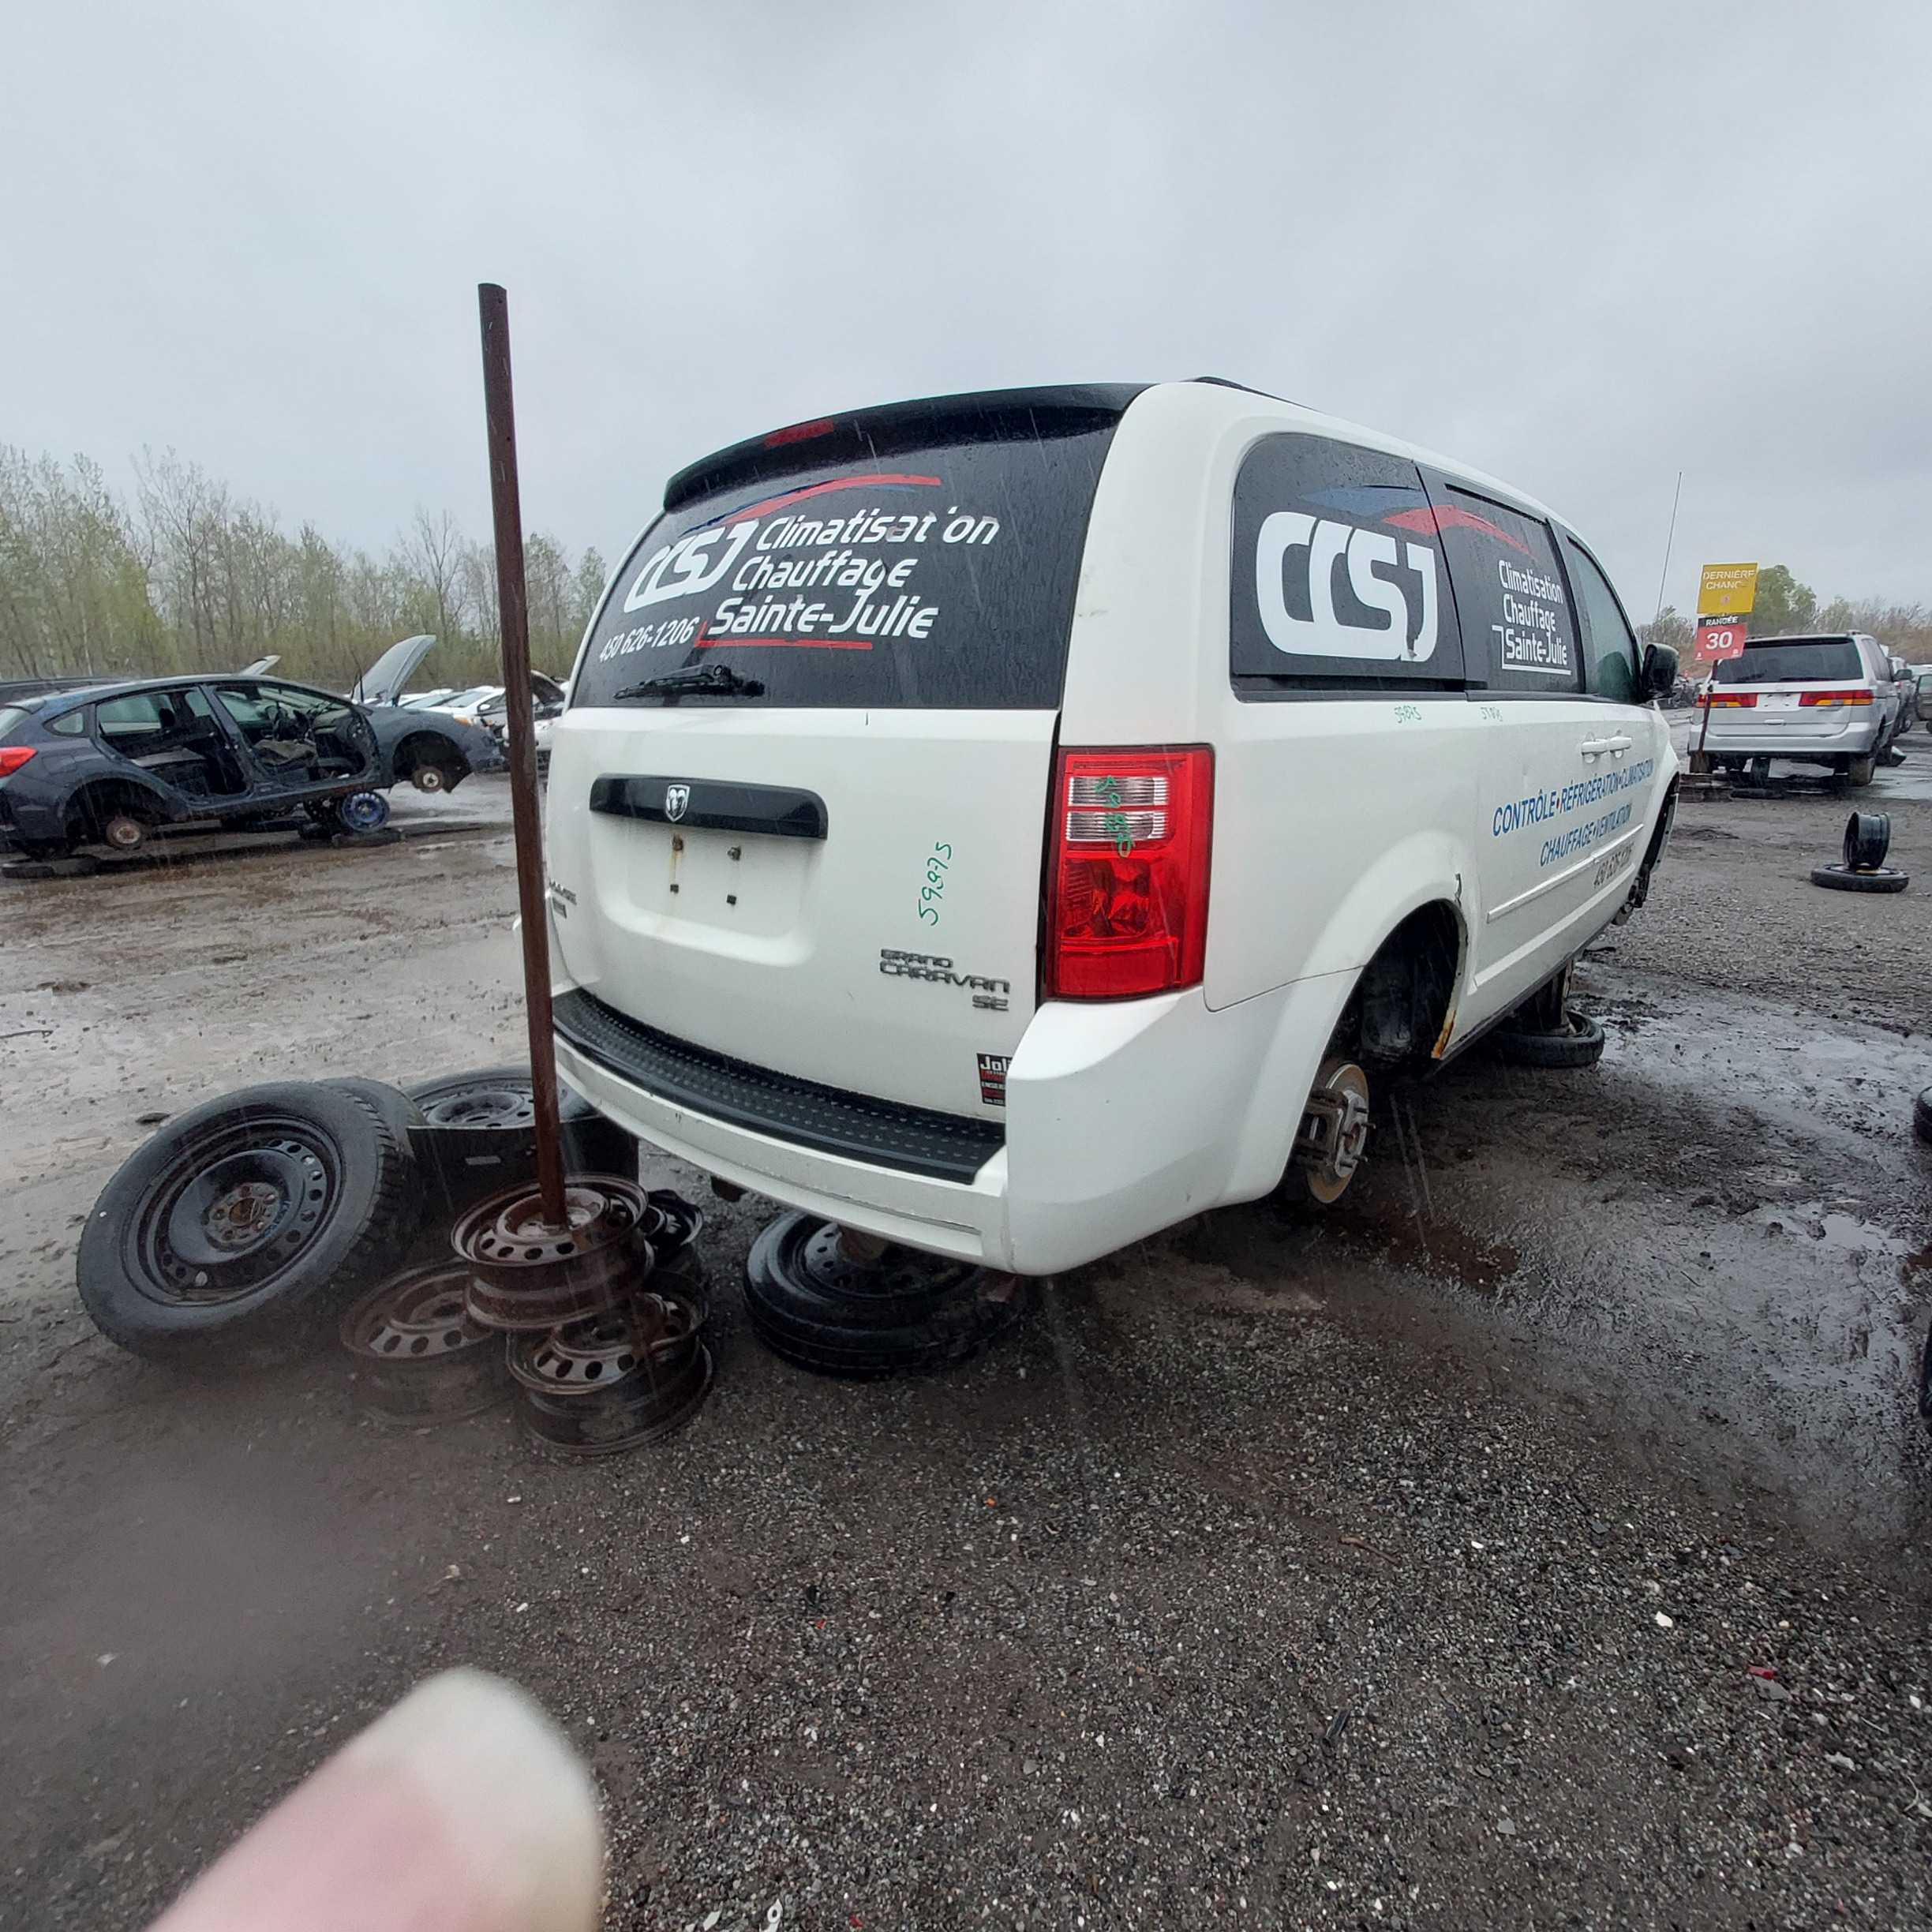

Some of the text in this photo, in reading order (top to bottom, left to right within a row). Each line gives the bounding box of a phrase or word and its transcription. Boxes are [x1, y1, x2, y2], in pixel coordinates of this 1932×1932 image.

[756, 507, 1000, 551] Climatisaton
[732, 550, 919, 593] Chauffage
[1499, 560, 1563, 605] Climatisation
[708, 589, 939, 638] Sainte-Julie
[1503, 593, 1556, 632] Chauffage
[599, 616, 701, 662] 450 626-1206
[1505, 628, 1568, 665] Sainte-Julie
[1705, 631, 1733, 650] 30
[1540, 822, 1594, 867] CHAUFFAGE
[880, 960, 1011, 994] CARAVAN
[972, 994, 1009, 1012] SE
